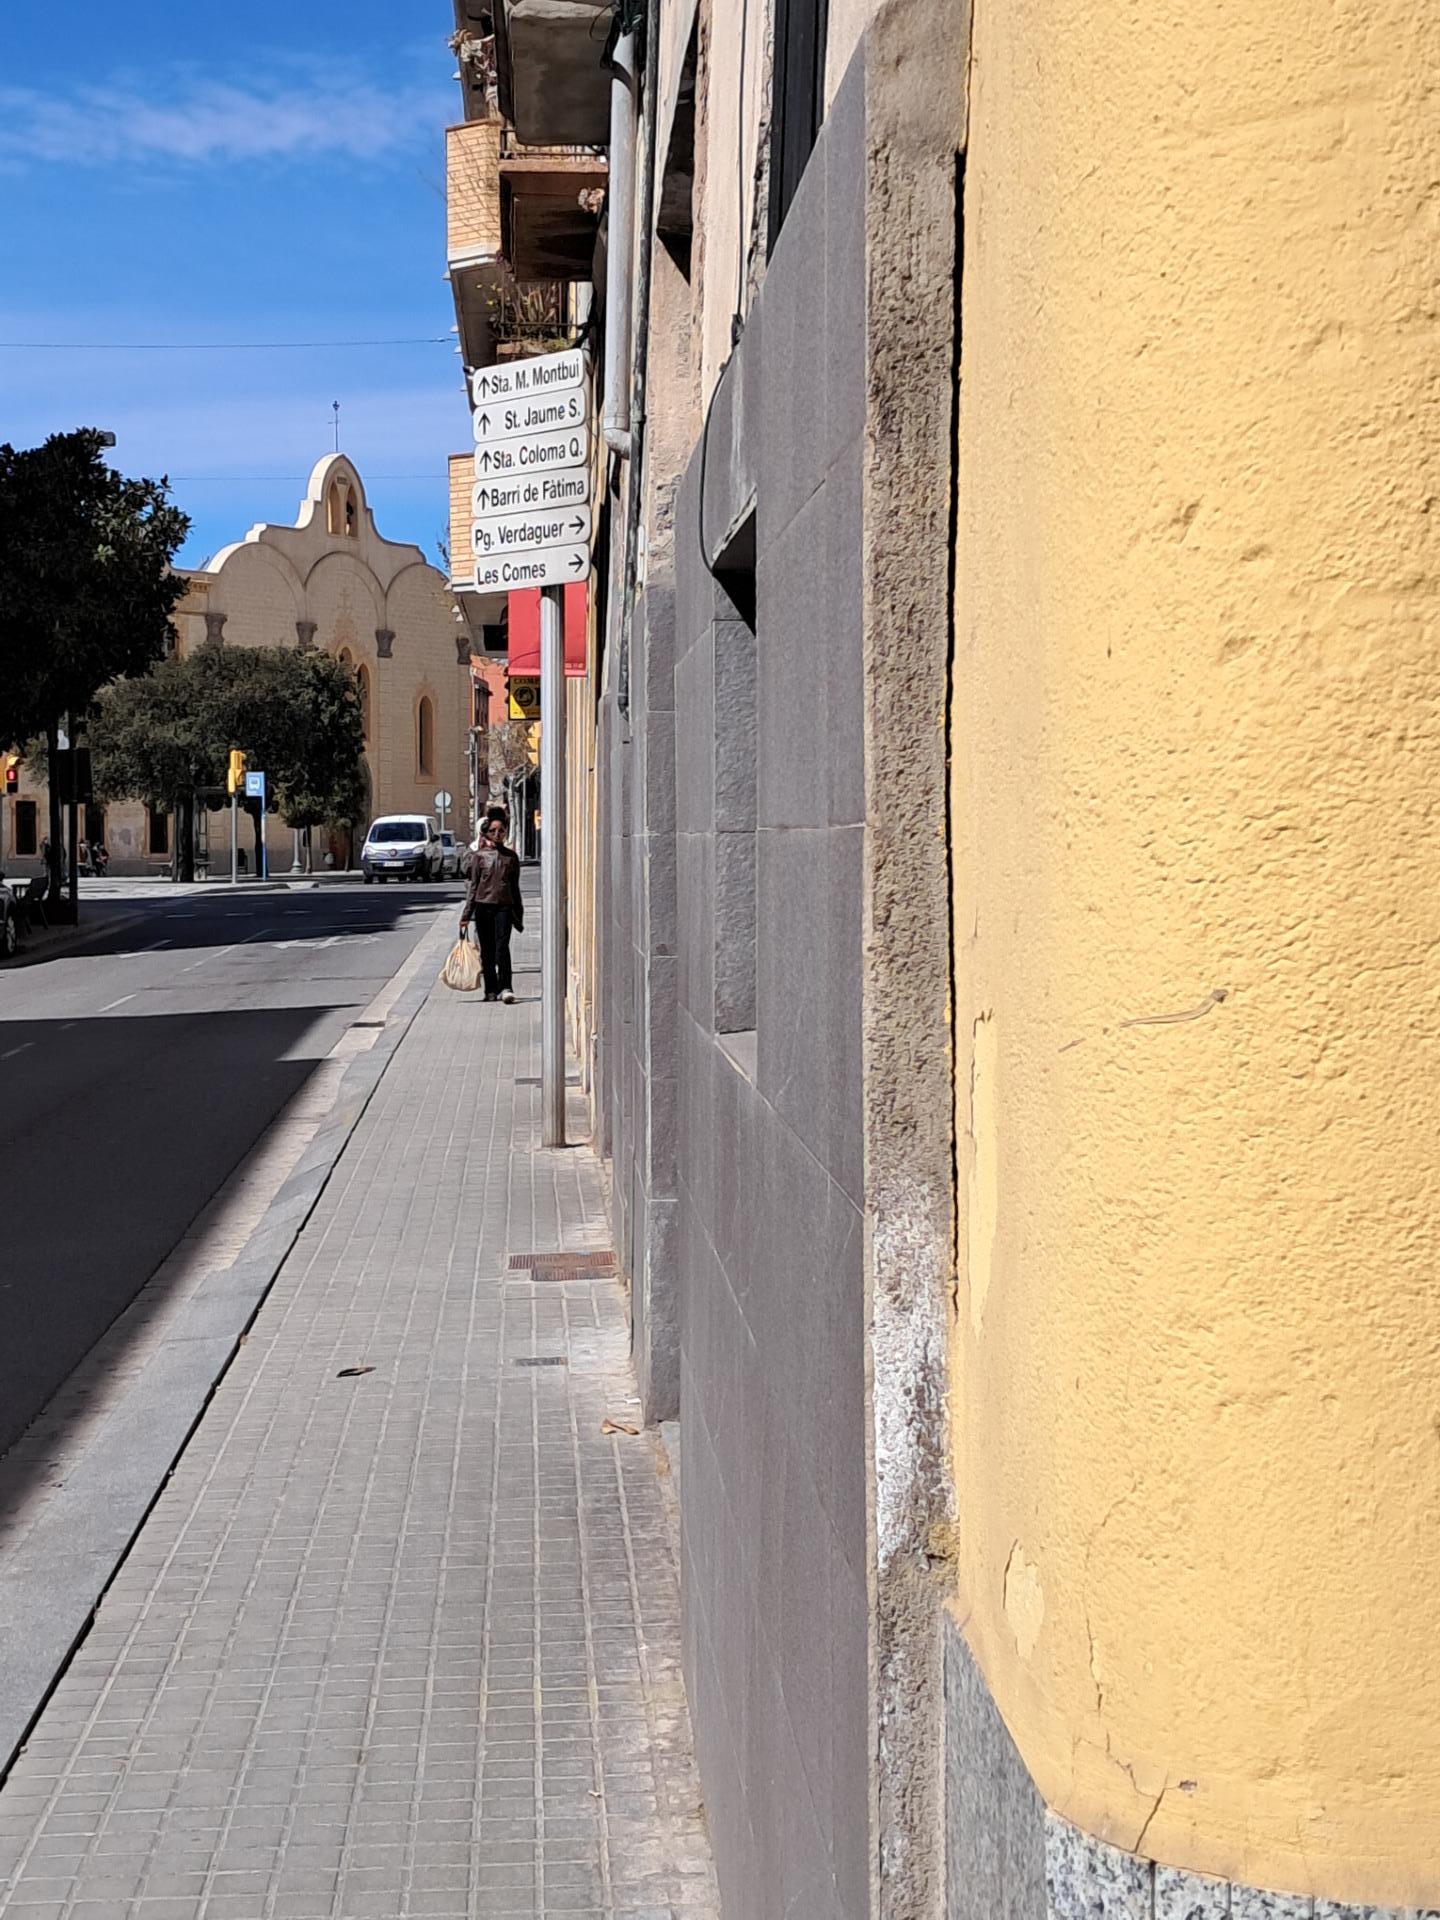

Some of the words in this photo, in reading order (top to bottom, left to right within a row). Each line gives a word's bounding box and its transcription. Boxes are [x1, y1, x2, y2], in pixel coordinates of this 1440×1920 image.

[491, 375, 512, 394] Sta.
[515, 371, 529, 389] M.
[531, 359, 579, 386] Montbui
[505, 411, 520, 430] St.
[525, 405, 566, 427] Jaume
[568, 398, 580, 418] S.
[493, 451, 515, 470] Sta.
[519, 444, 566, 465] Coloma
[569, 438, 582, 457] Q.
[491, 487, 520, 507] Barri
[524, 483, 539, 502] de
[543, 479, 584, 499] Fàtima
[475, 529, 494, 551] Pg.
[498, 522, 564, 546] Verdaguer
[477, 567, 498, 586] Les
[502, 562, 546, 581] Comes
